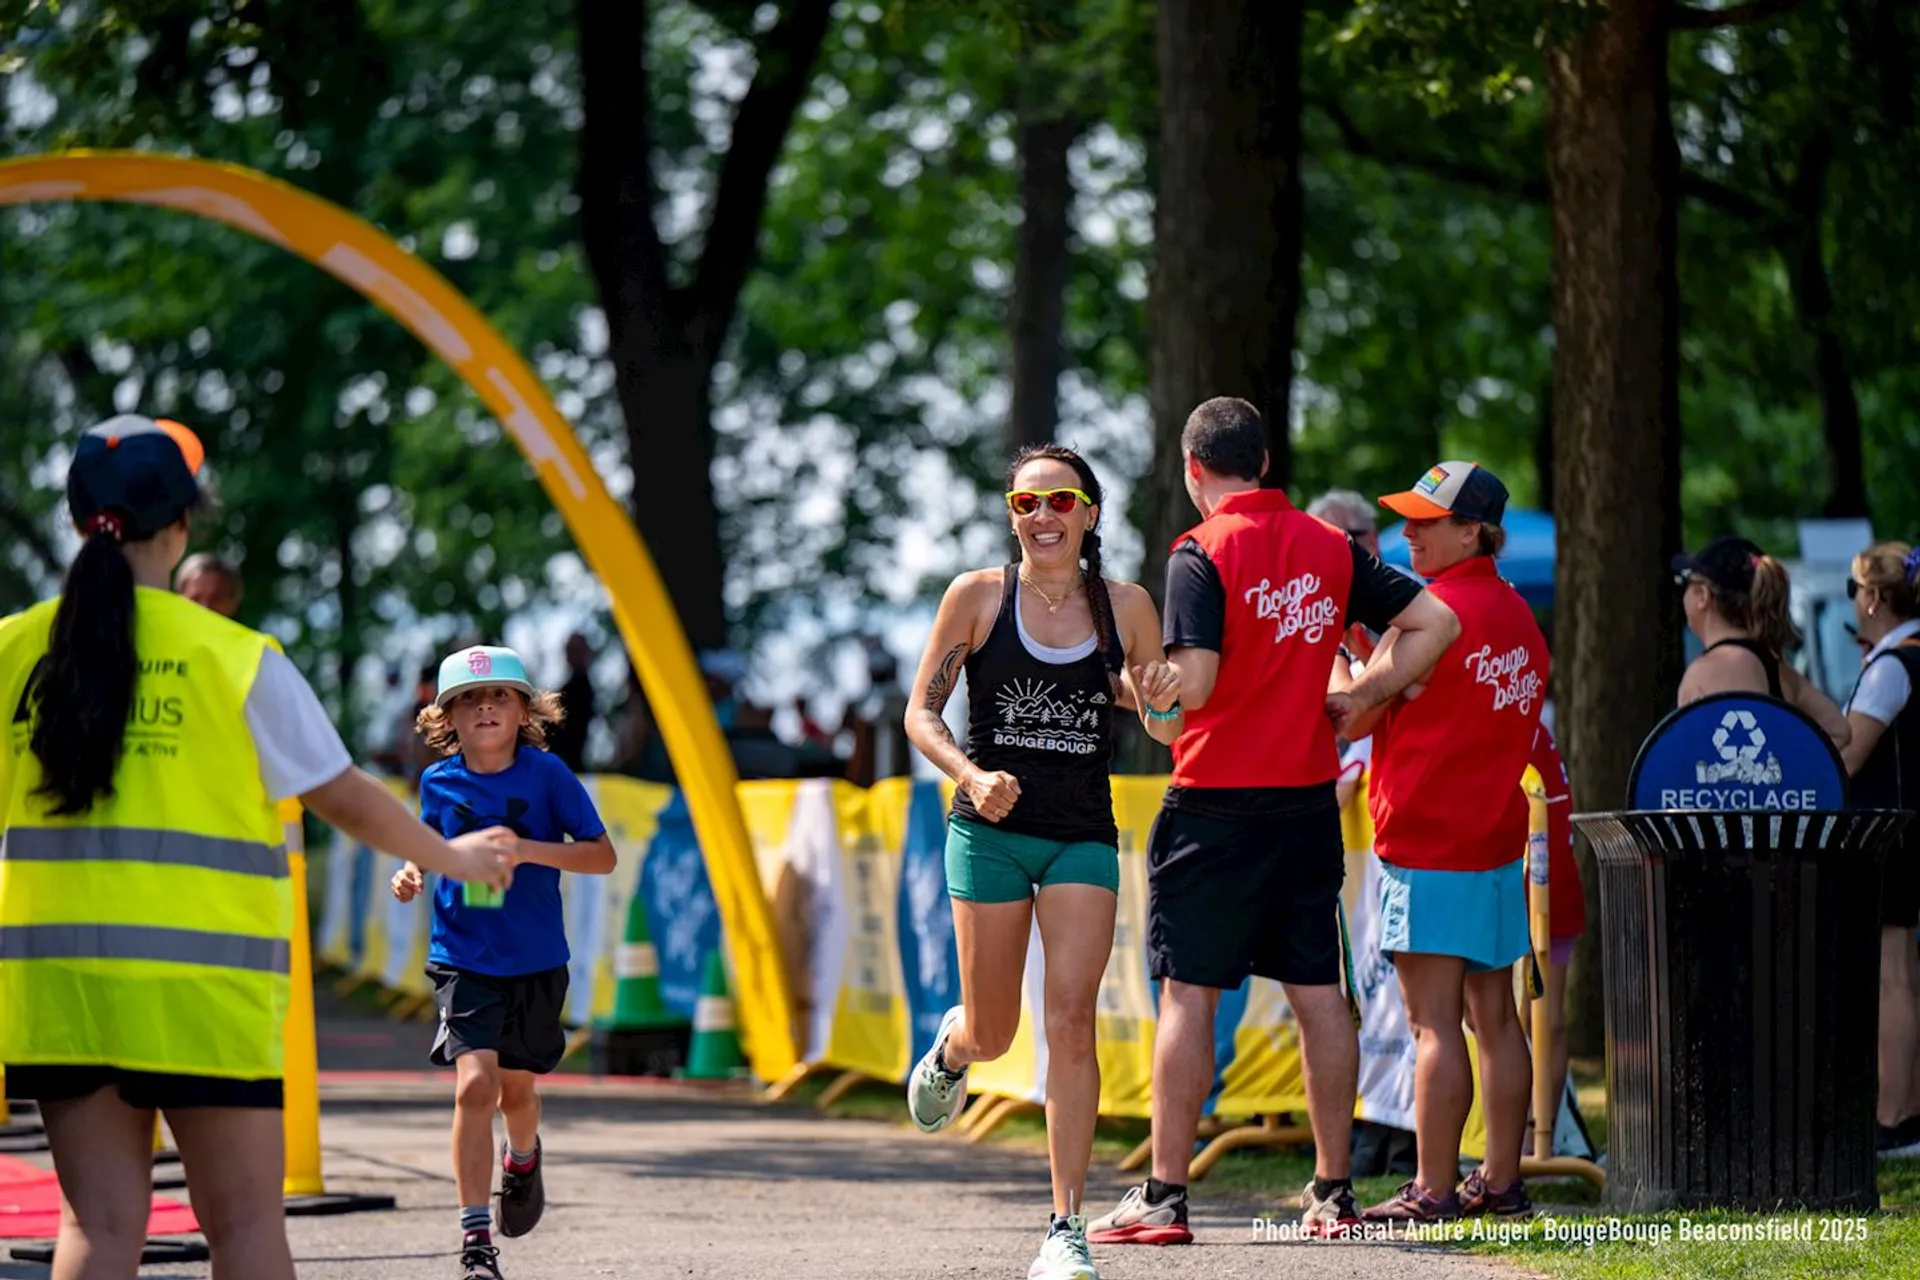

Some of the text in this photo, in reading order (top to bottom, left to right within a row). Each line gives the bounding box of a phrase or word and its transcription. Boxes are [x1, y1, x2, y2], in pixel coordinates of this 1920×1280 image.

[138, 659, 188, 677] UIPE
[1465, 645, 1528, 683] bouge
[1661, 789, 1817, 810] RECYCLAGE
